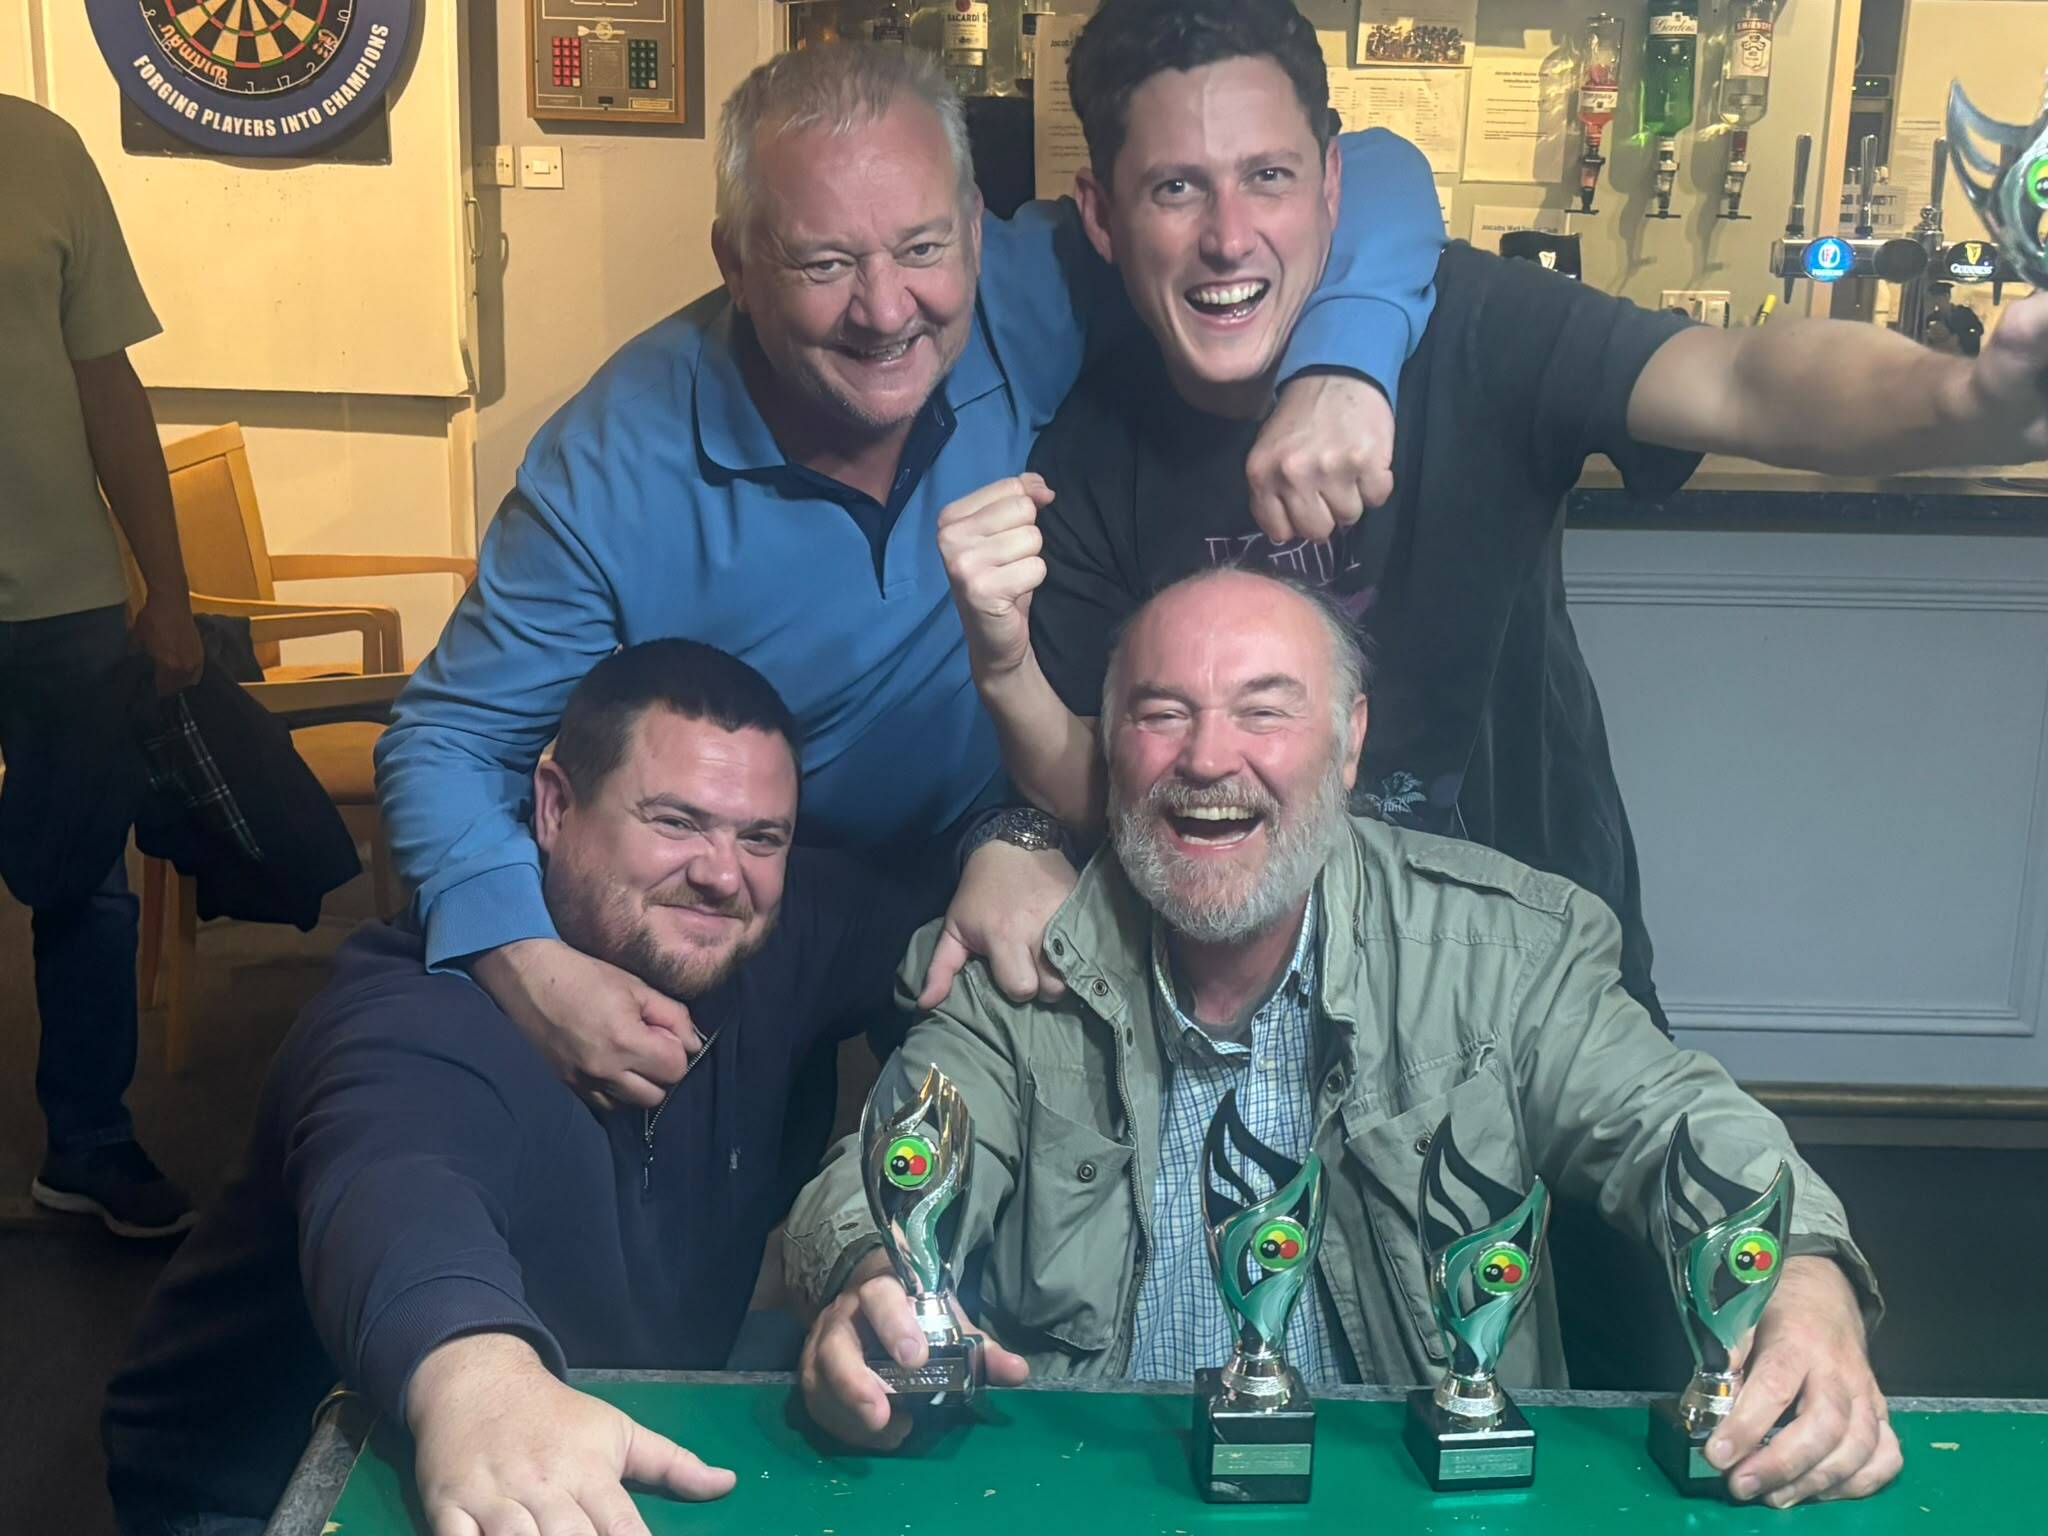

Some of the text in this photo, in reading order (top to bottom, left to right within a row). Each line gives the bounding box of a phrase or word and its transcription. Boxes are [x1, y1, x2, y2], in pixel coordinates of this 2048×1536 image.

[133, 23, 389, 137] FORGING PLAYERS INTO CHAMPIONS
